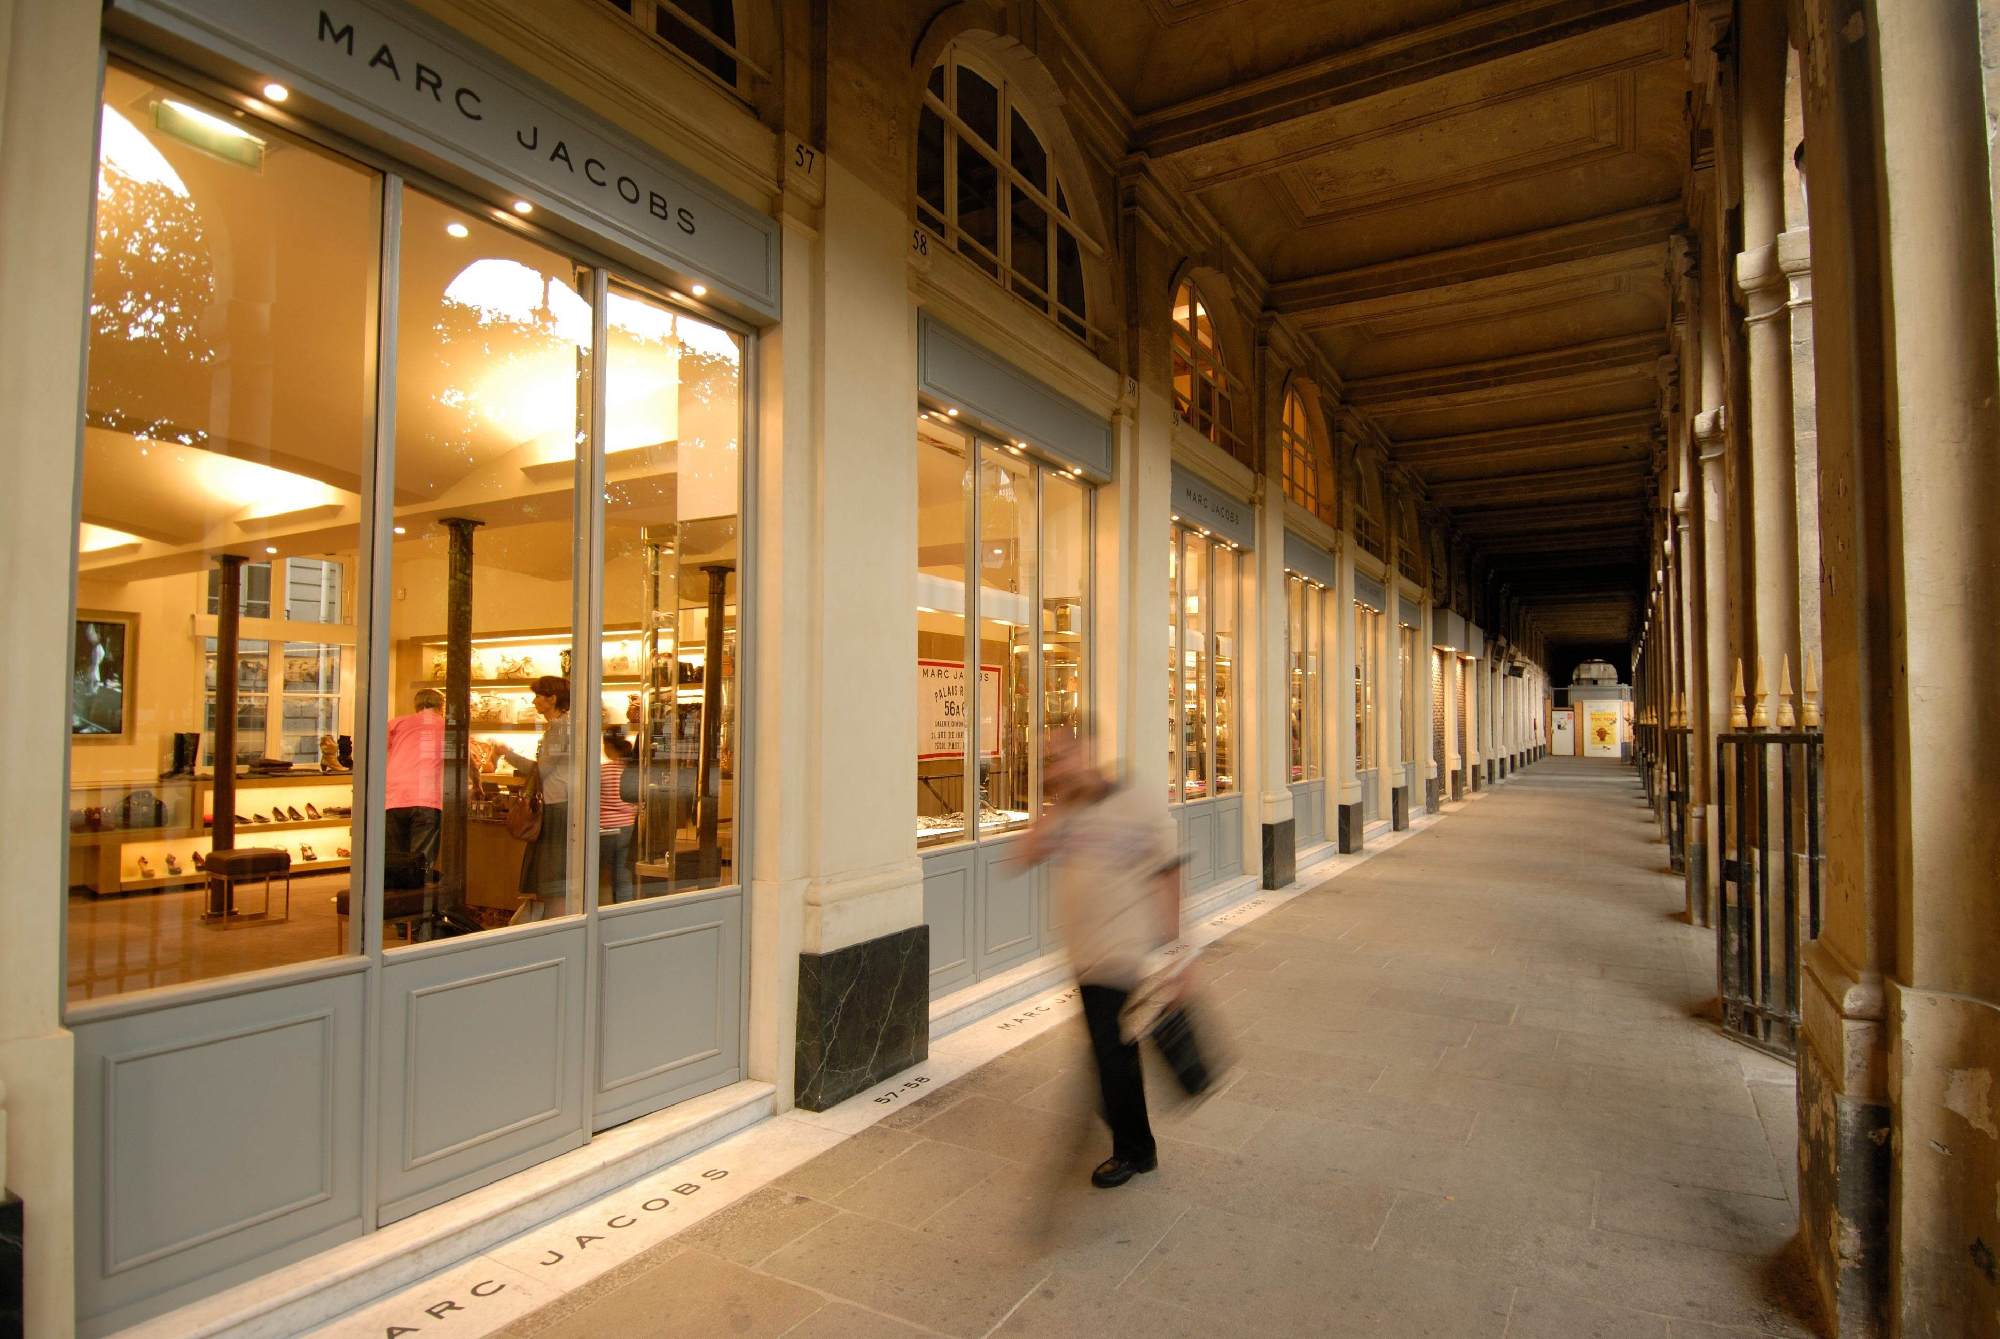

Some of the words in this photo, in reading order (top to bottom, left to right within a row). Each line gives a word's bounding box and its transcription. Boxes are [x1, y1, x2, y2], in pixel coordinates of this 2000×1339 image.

[318, 10, 482, 121] MARC
[516, 126, 697, 236] JACOBS
[795, 143, 815, 174] 57
[912, 229, 927, 256] 58
[1185, 487, 1208, 509] MARC
[1210, 502, 1240, 525] JACOBS
[922, 668, 950, 679] MARC
[997, 1006, 1051, 1031] MARC
[873, 1076, 930, 1104] 57-58
[385, 1279, 507, 1339] ARC
[539, 1166, 730, 1267] JACOBS
